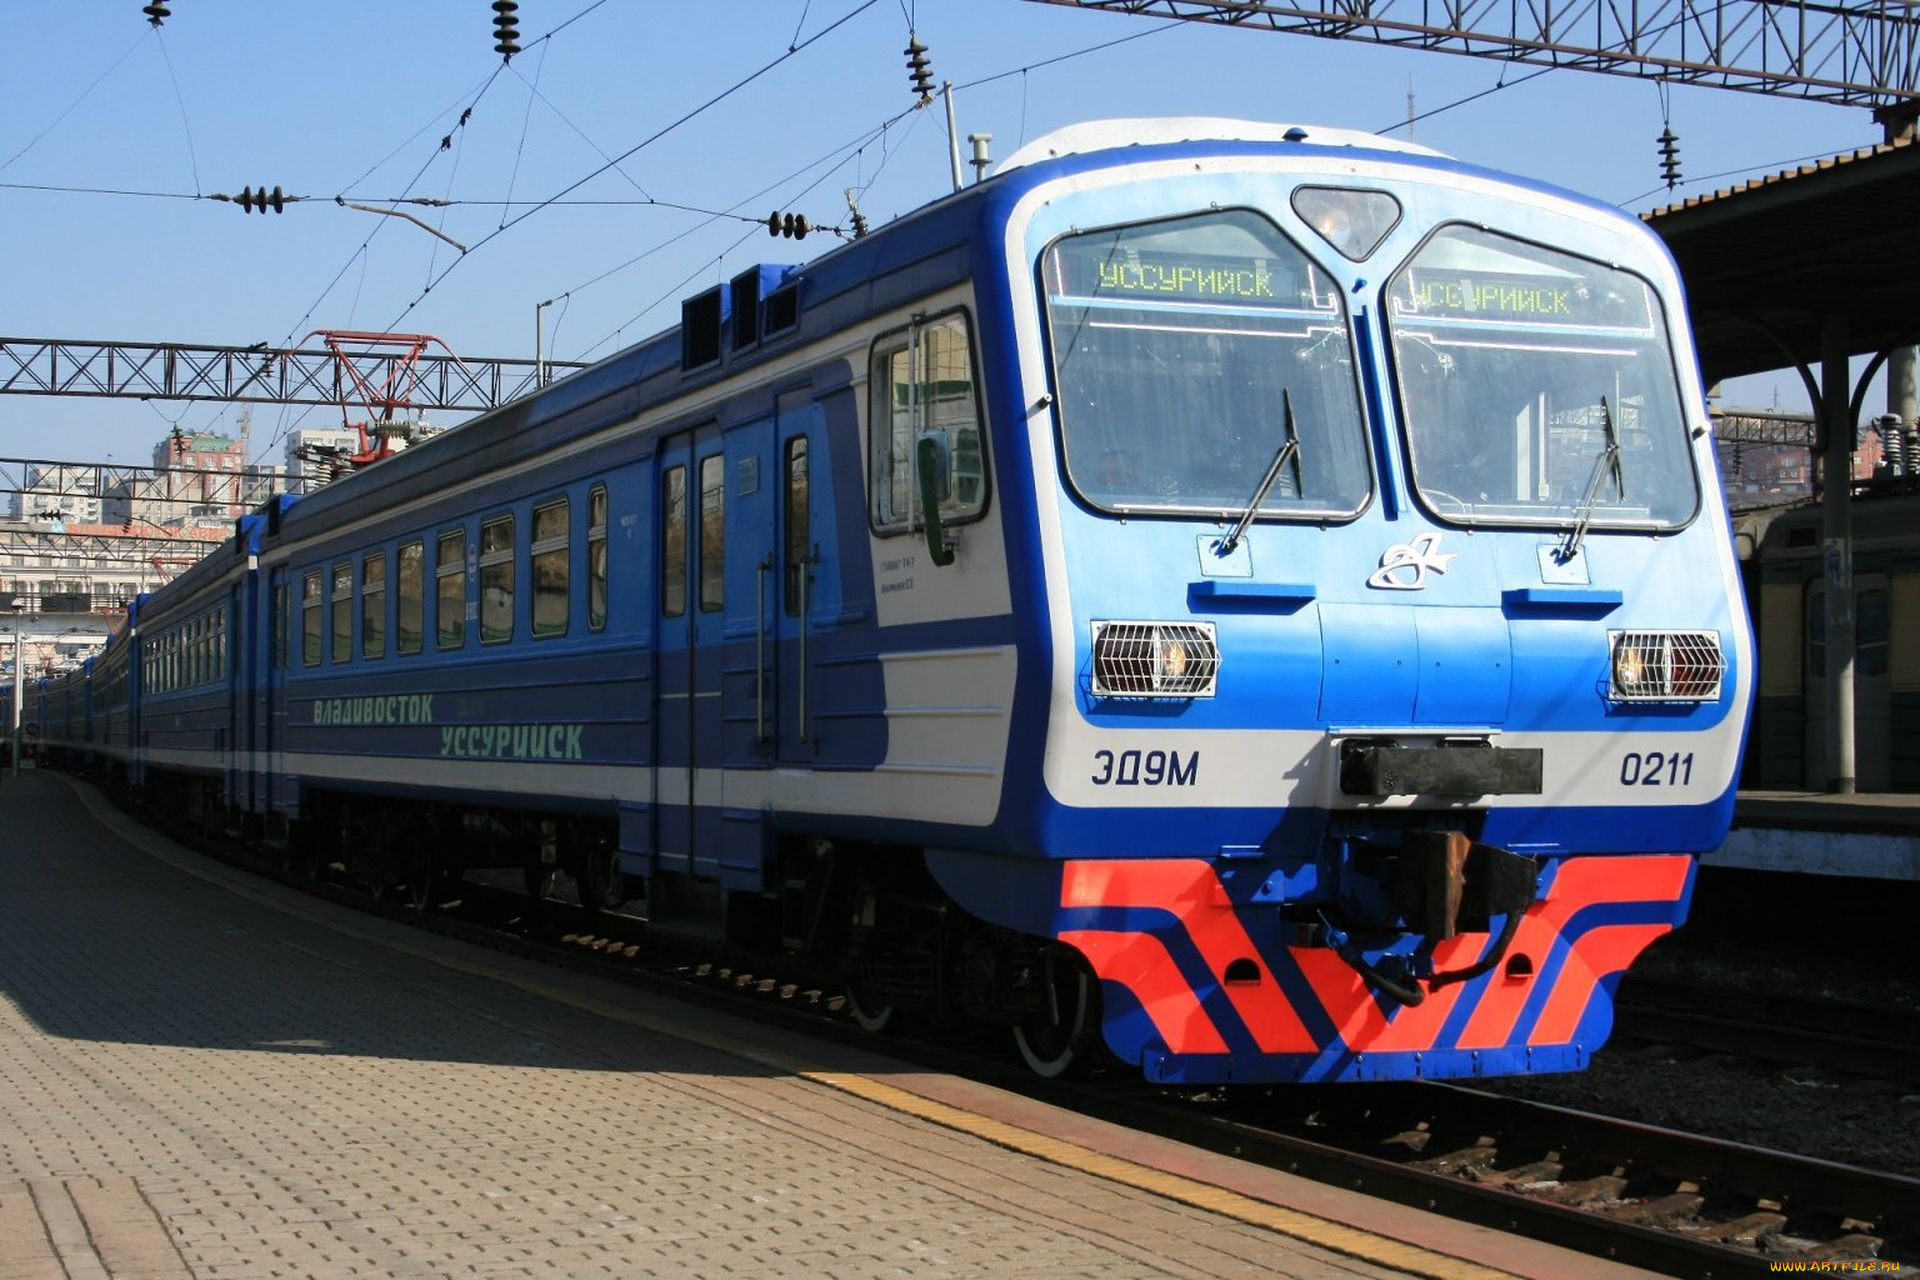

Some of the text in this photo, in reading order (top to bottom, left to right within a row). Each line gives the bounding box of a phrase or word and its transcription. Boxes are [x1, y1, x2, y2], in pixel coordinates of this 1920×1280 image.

[440, 723, 584, 760] УССУРИЙСК
[1091, 749, 1200, 786] ЭД9М
[1620, 752, 1694, 786] 0211
